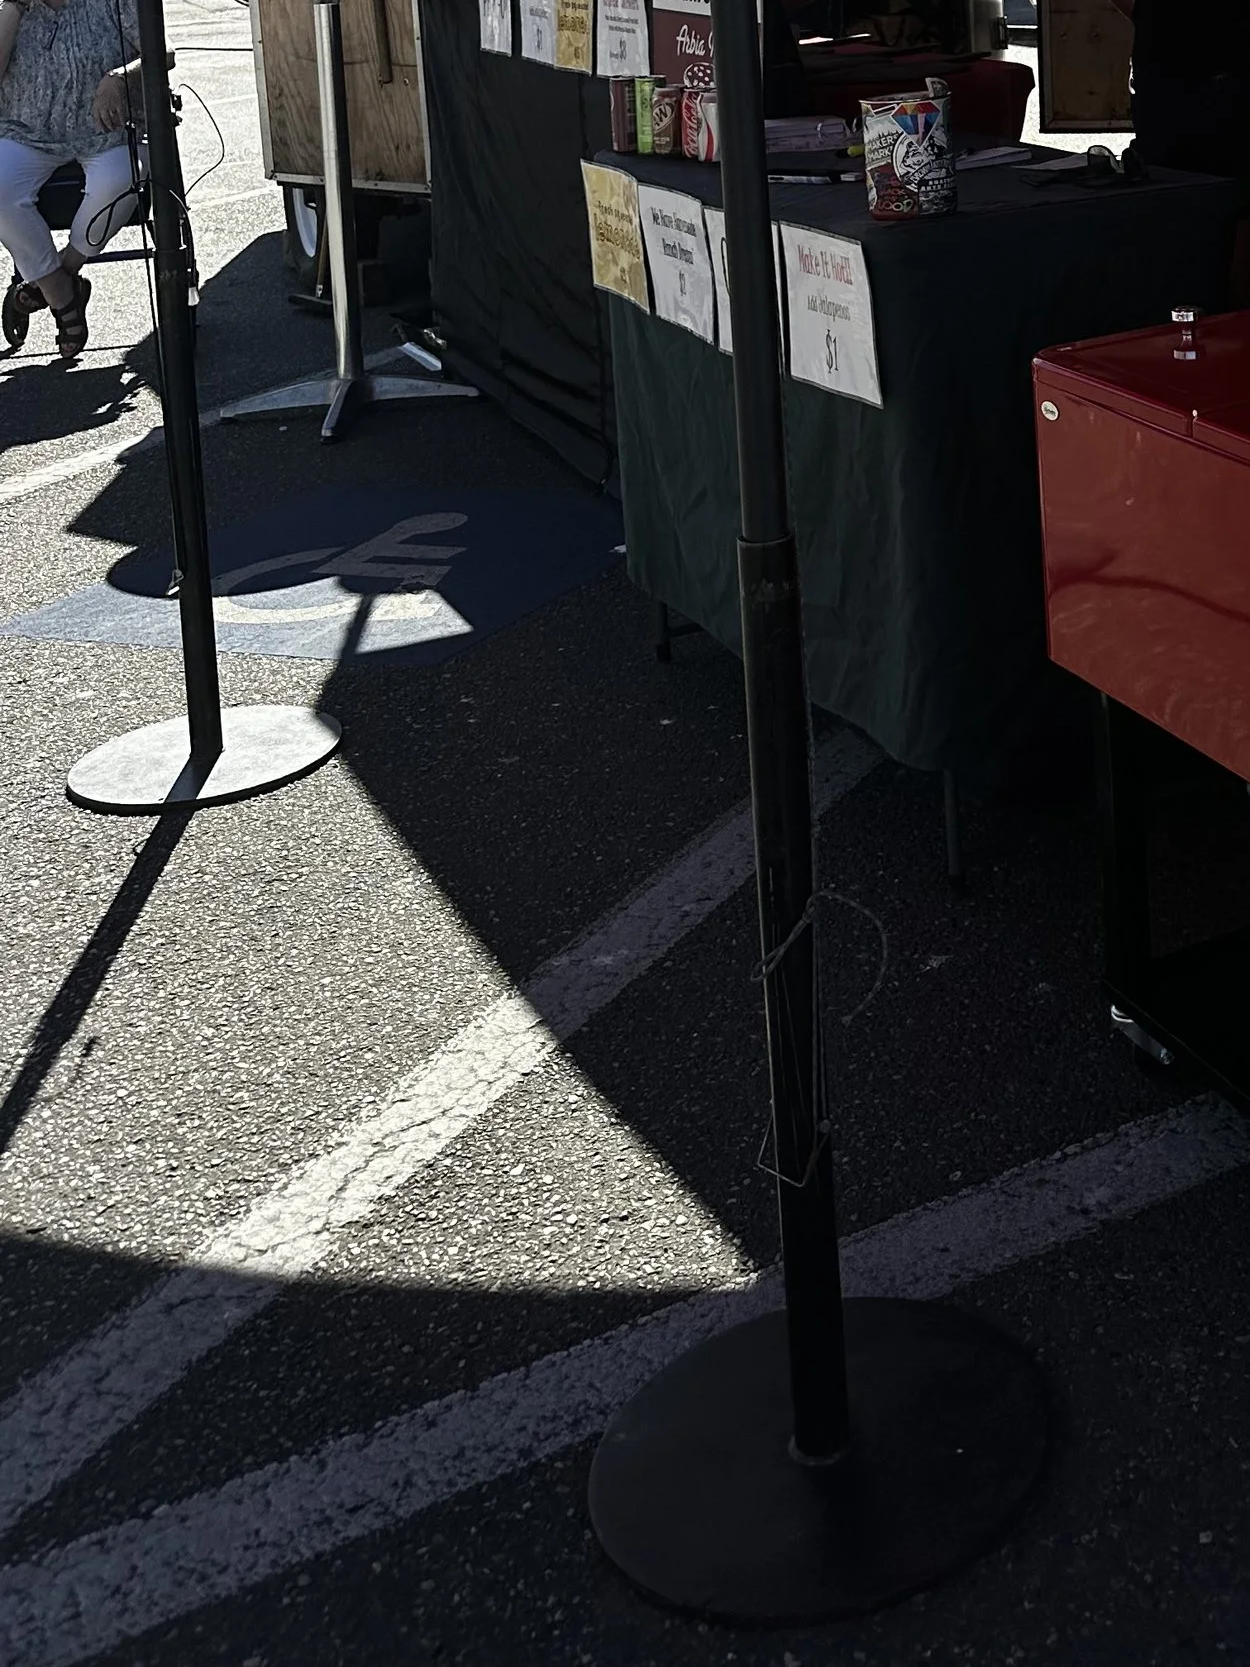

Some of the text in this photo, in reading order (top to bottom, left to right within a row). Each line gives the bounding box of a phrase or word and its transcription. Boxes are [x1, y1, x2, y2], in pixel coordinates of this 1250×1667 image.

[676, 24, 706, 56] Arbia
[797, 244, 820, 276] Make
[820, 251, 831, 279] It
[825, 329, 839, 374] $1
